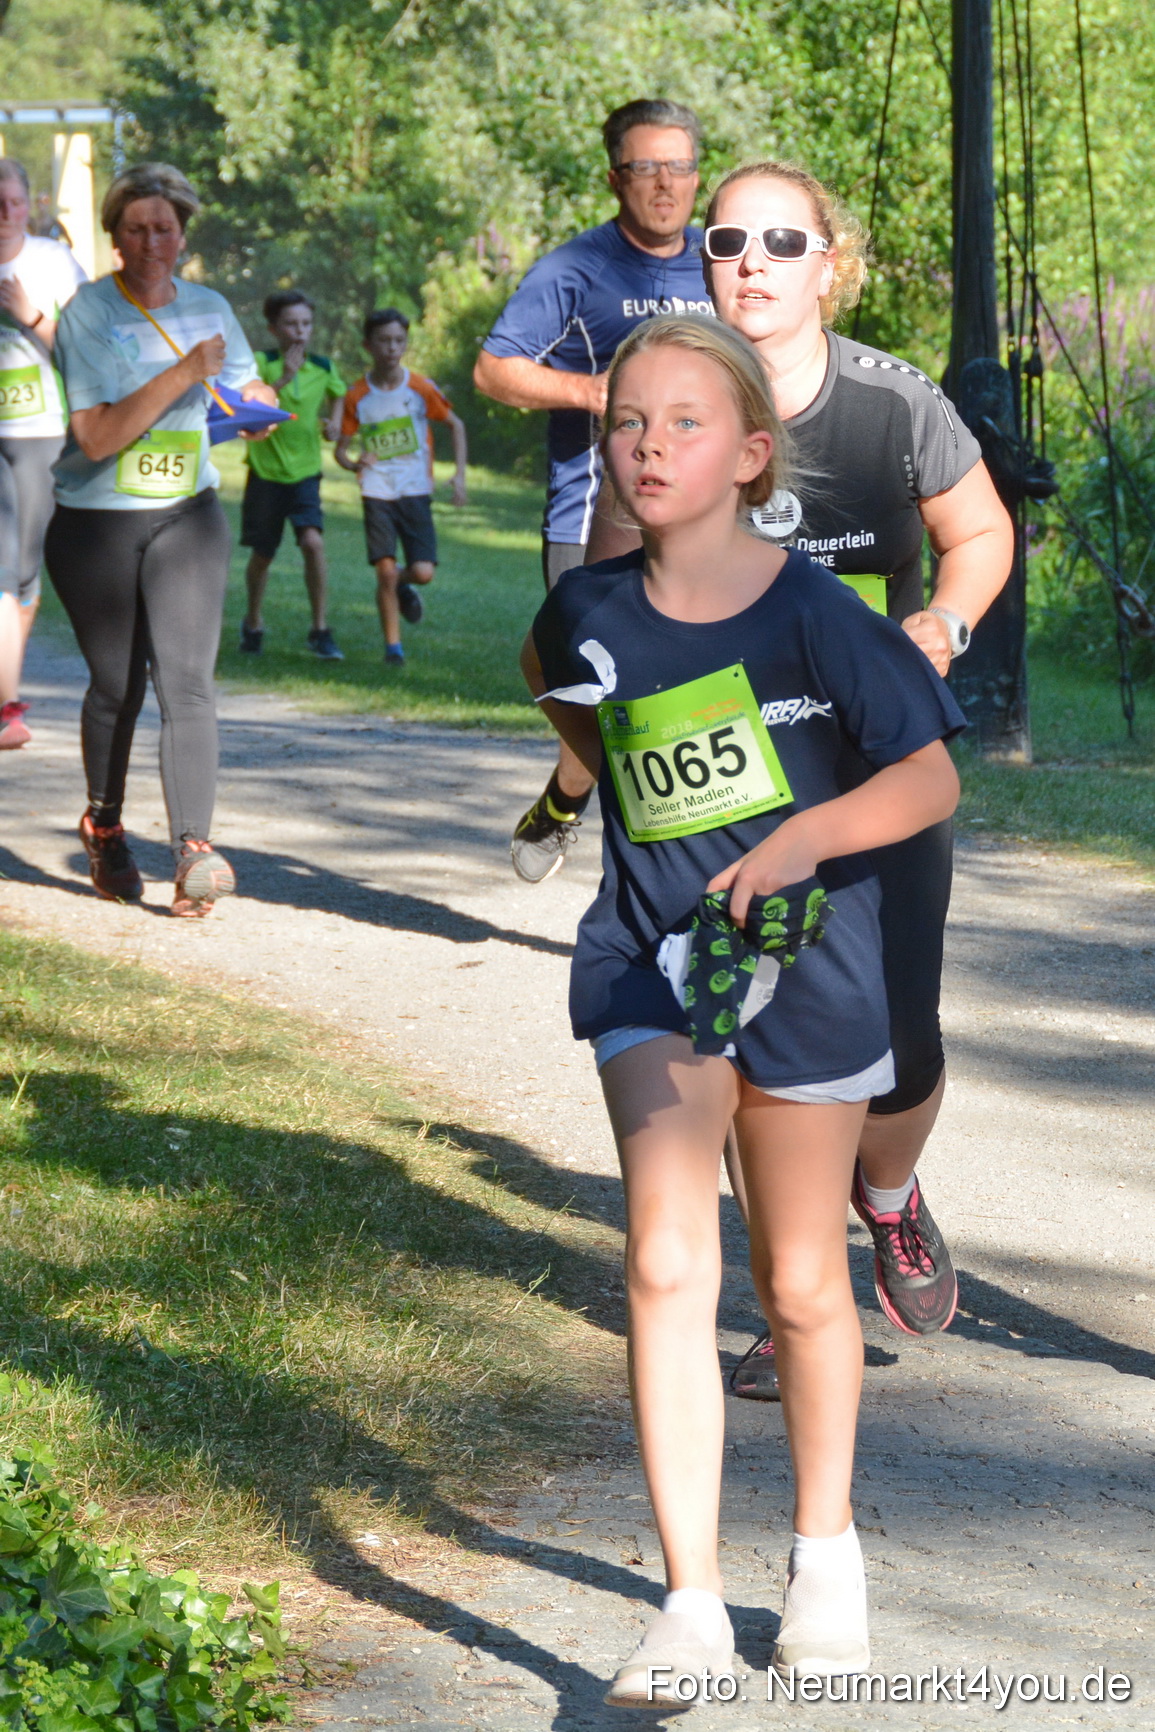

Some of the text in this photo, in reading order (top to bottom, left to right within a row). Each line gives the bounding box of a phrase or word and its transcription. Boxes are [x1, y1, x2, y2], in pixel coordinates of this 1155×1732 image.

[370, 428, 409, 449] 1673
[138, 453, 185, 478] 645
[797, 530, 875, 553] Deuerlein
[661, 719, 693, 739] 2018
[622, 725, 747, 802] 1065
[643, 812, 687, 828] Lebenshilfe
[688, 801, 733, 820] Neumarkt
[734, 792, 753, 805] e.V.
[648, 786, 735, 816] Seller Madlen
